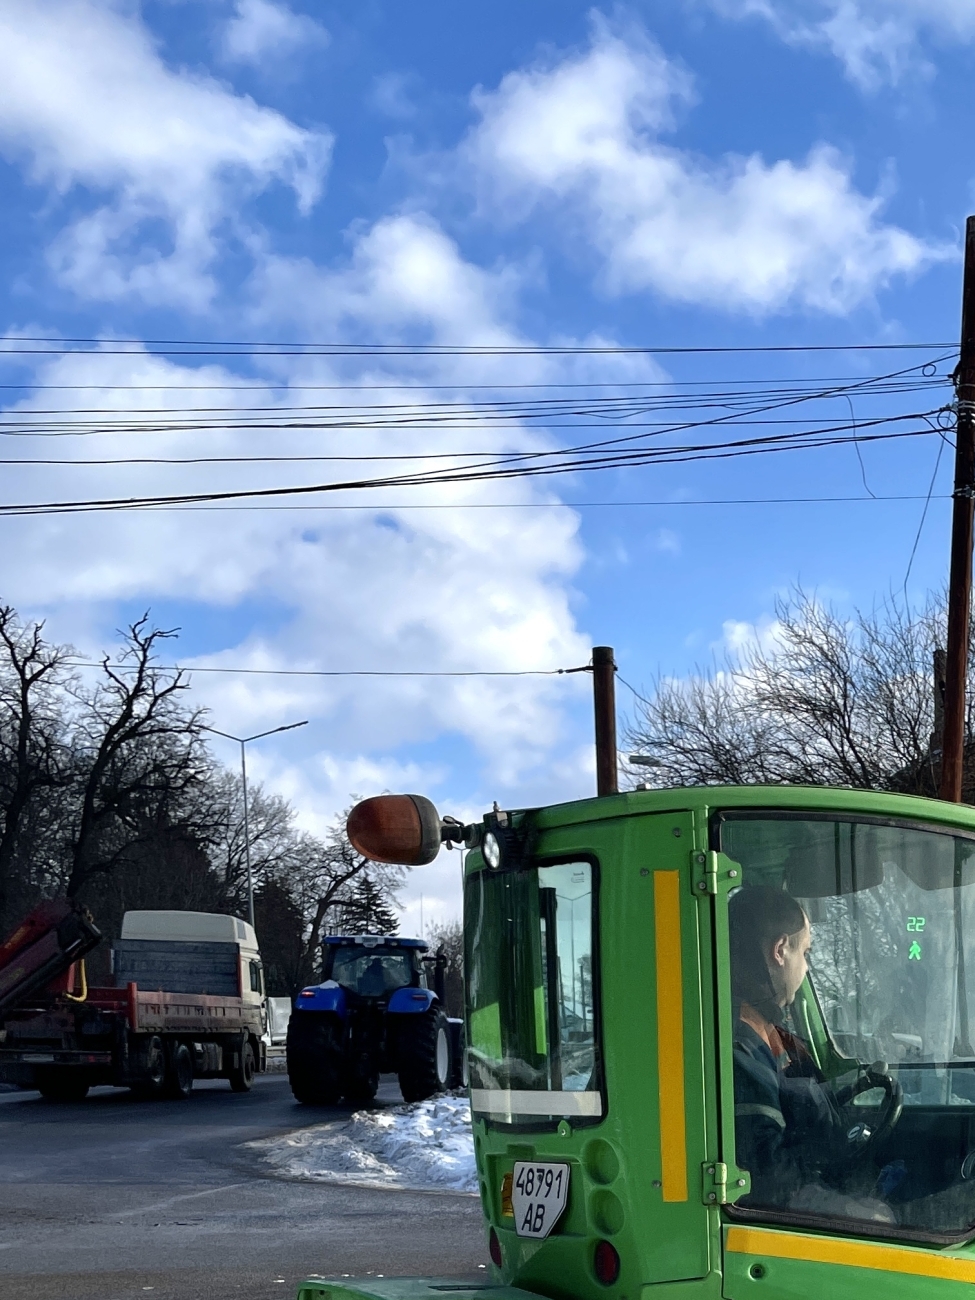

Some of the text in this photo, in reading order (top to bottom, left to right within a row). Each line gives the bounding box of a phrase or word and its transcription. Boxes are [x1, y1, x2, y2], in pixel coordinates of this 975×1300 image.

[907, 917, 925, 932] 22
[516, 1167, 563, 1199] 48791
[521, 1203, 545, 1232] AB
